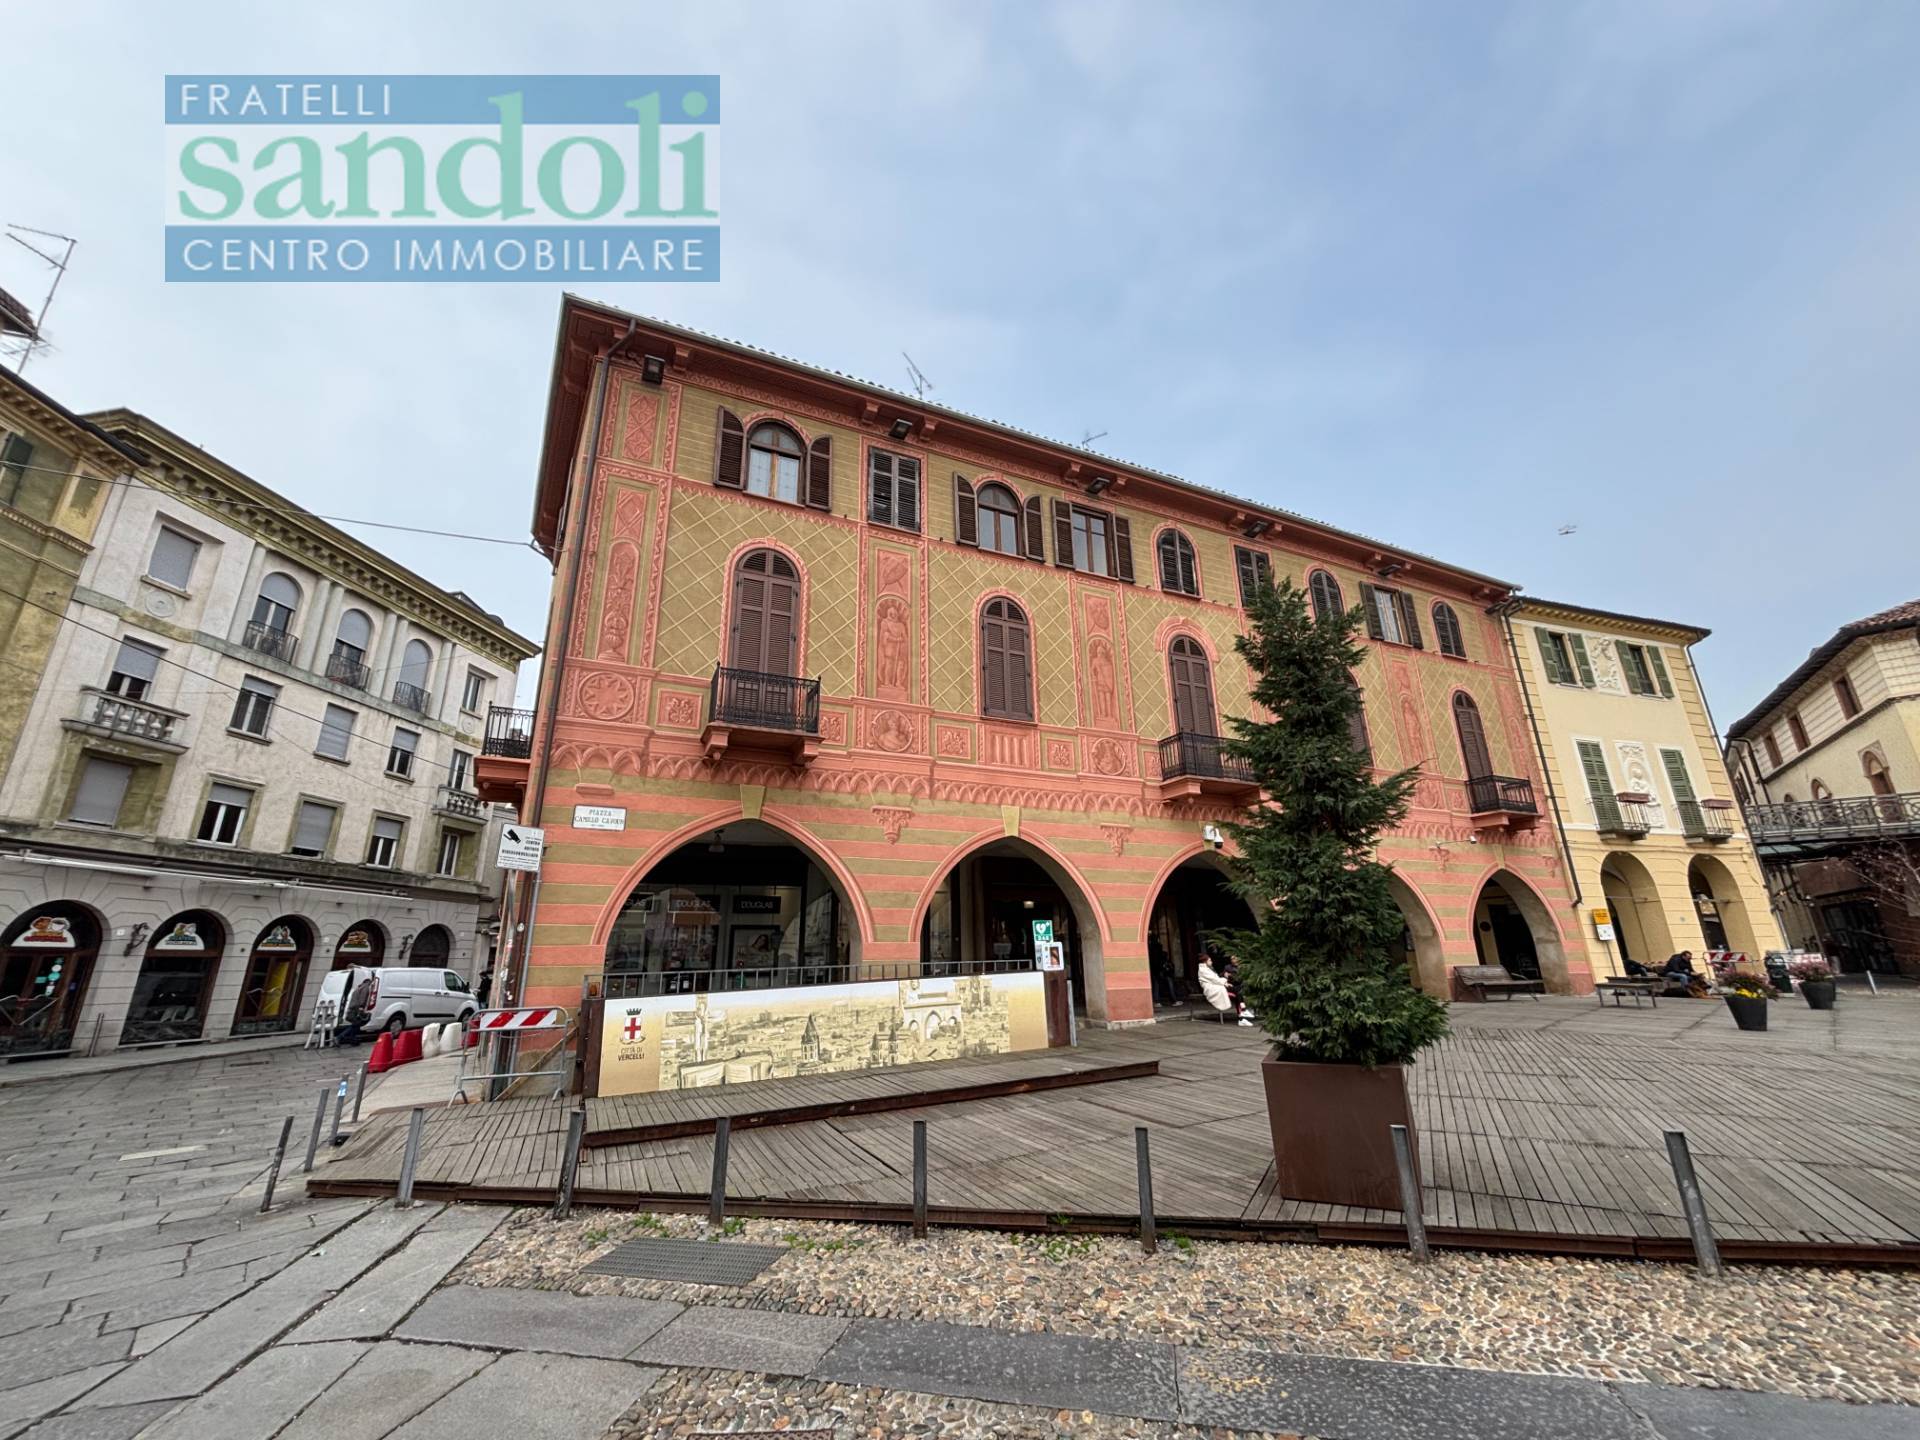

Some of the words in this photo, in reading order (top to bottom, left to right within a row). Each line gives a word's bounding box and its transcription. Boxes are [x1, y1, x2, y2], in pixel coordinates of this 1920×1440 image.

[675, 899, 712, 908] DOUGLAS
[740, 901, 774, 909] DOUGLAS
[617, 1052, 645, 1061] VERCELLI
